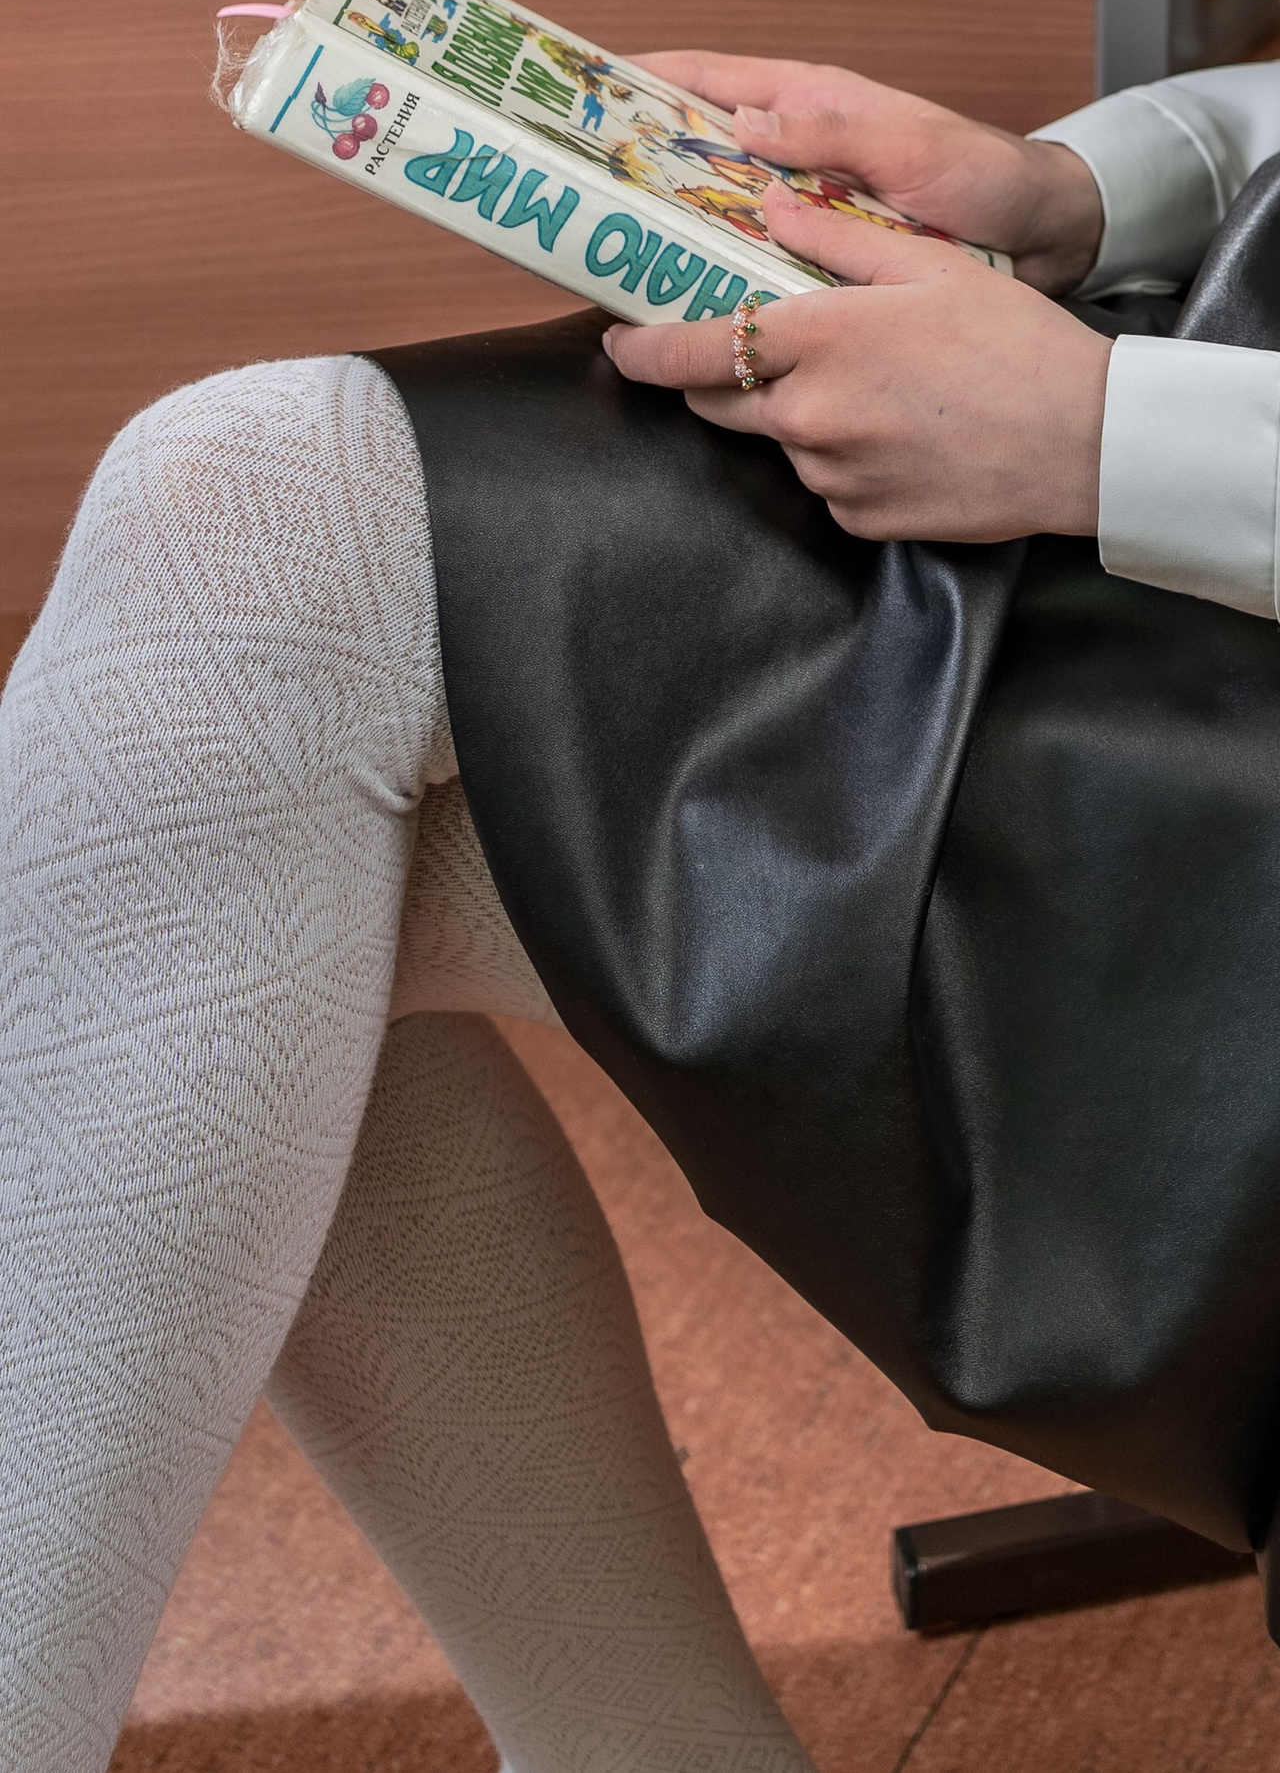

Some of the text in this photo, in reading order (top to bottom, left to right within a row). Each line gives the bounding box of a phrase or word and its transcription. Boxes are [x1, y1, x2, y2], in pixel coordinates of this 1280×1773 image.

[430, 0, 527, 107] Я ПОЗНАЮ
[510, 57, 578, 119] МИР
[364, 91, 421, 176] РАСТЕНИЯ
[404, 127, 580, 253] МИР
